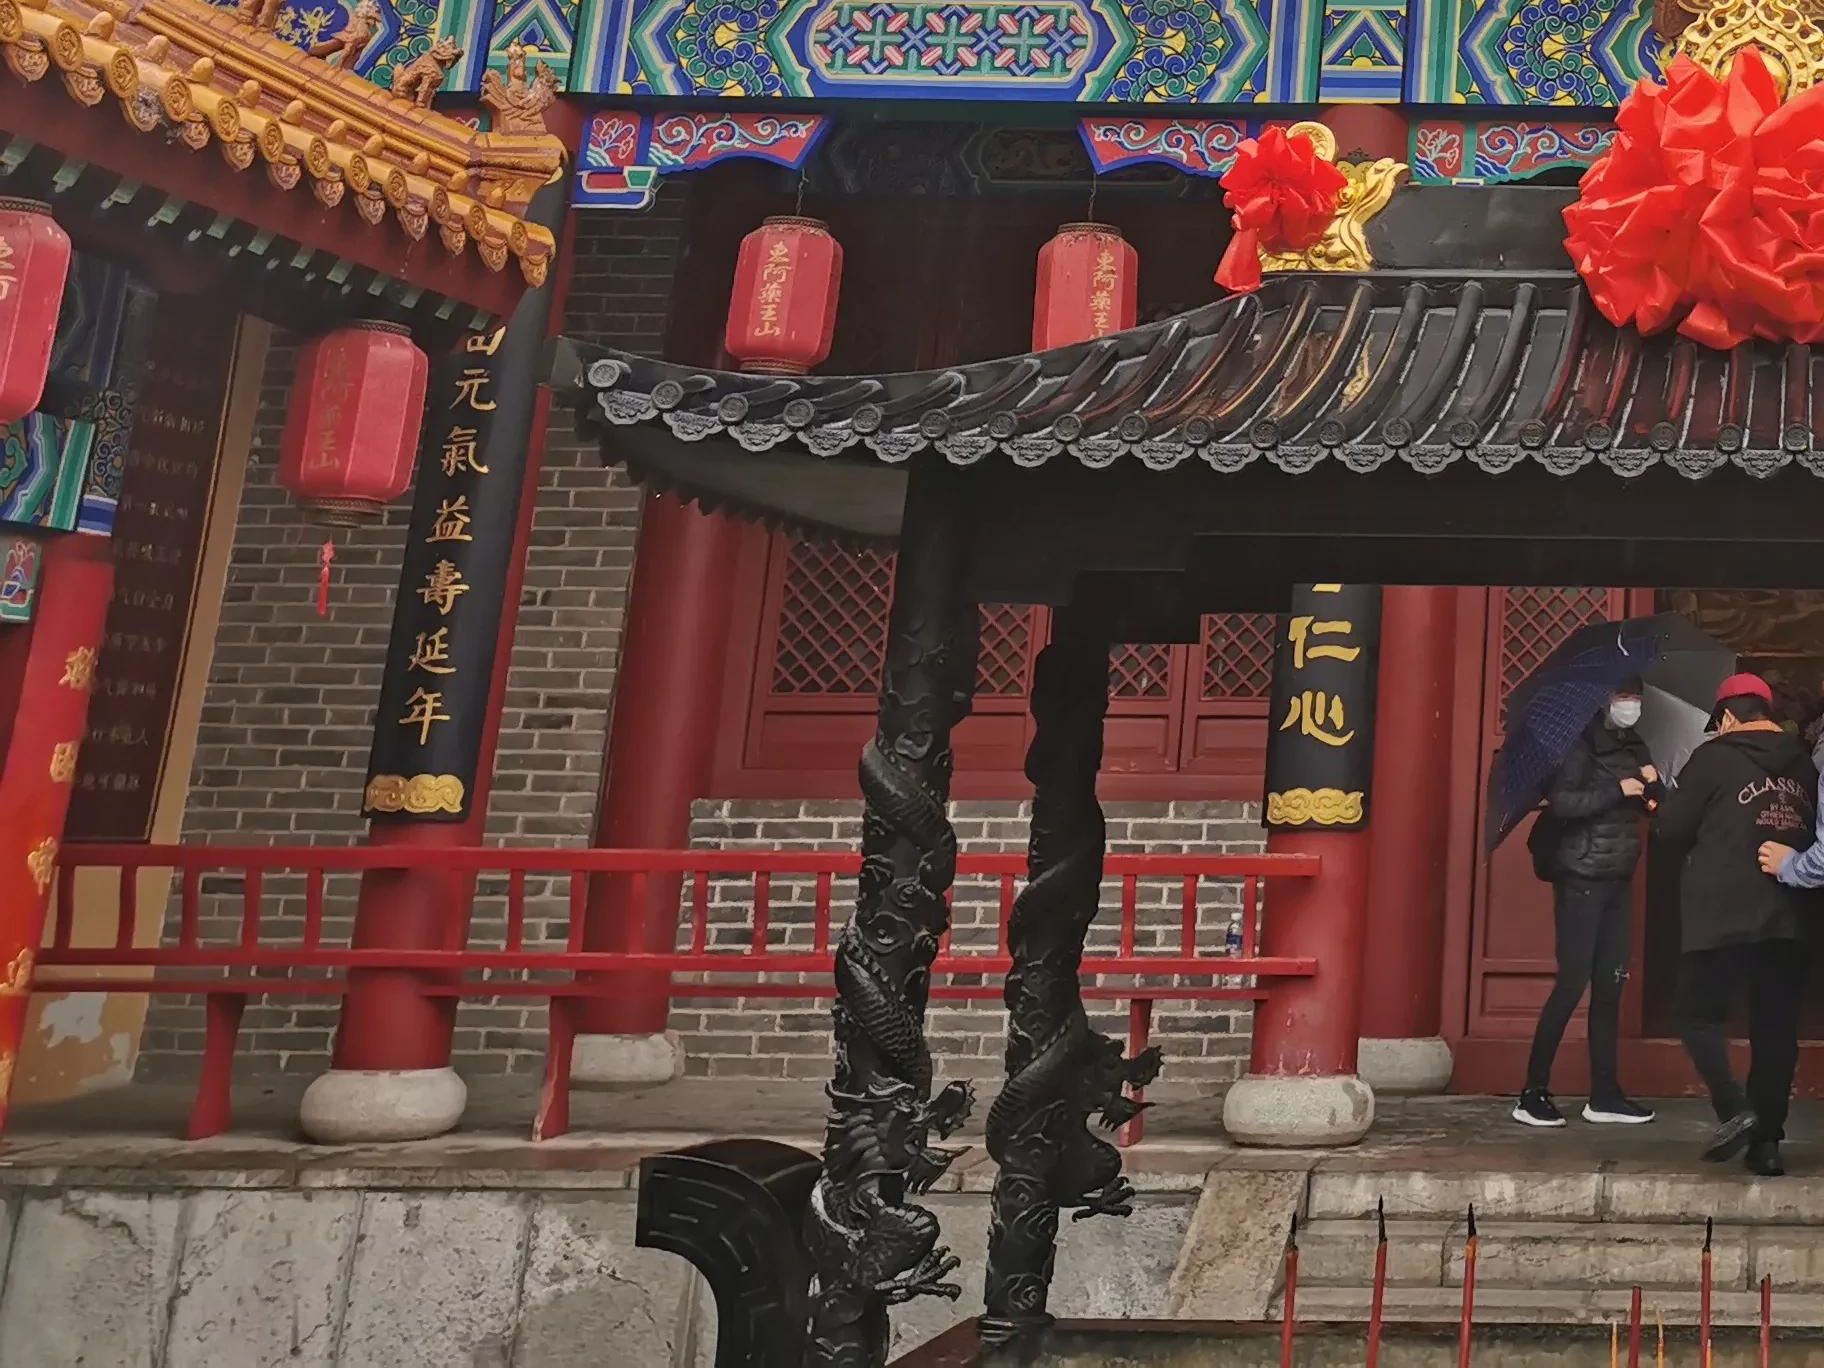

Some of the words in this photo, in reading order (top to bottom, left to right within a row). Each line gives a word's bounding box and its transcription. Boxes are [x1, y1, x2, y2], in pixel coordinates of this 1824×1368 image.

[1089, 249, 1118, 337] 東阿藥王
[1279, 583, 1361, 746] 仁心
